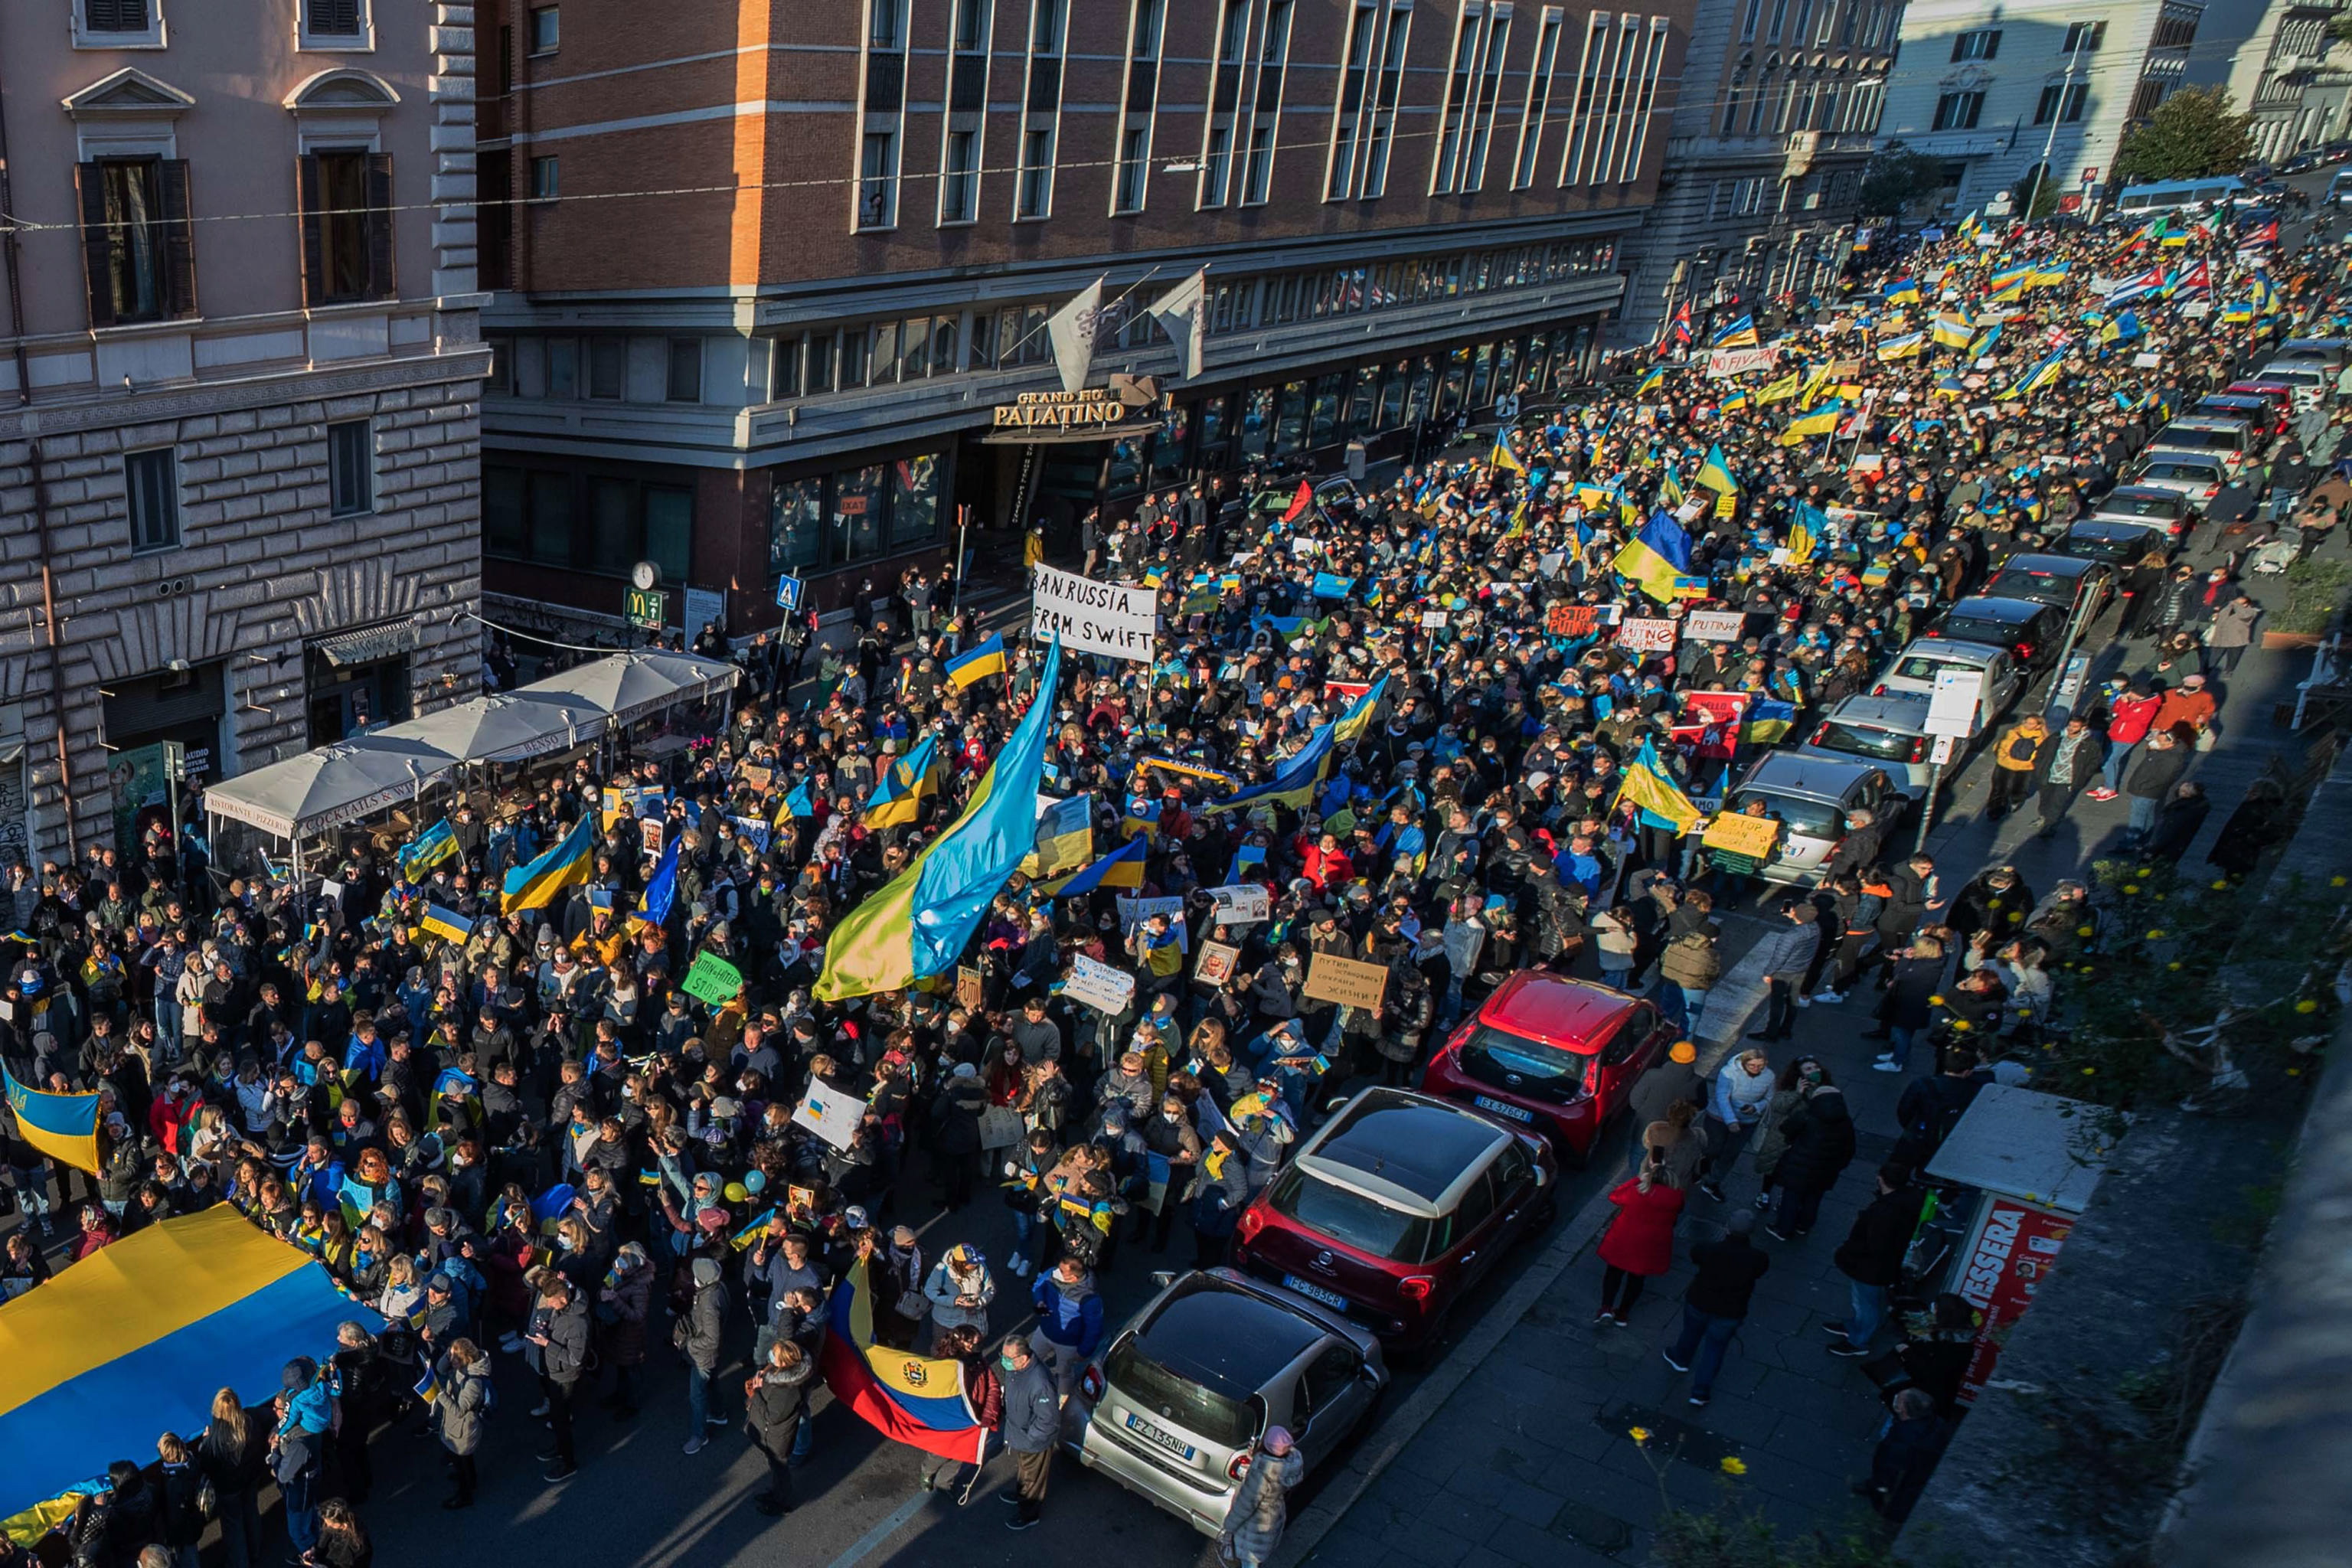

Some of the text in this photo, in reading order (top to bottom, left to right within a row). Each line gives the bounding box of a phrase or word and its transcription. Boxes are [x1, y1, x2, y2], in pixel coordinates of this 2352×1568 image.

[1018, 391, 1074, 404] GRAND
[994, 402, 1125, 426] PALATINO
[1033, 569, 1063, 597] BAN
[1034, 606, 1073, 635] FROM
[1560, 606, 1599, 621] STOP
[1548, 619, 1584, 635] PUTIN
[1622, 627, 1656, 640] PUTIN
[524, 735, 559, 753] BENSO
[210, 798, 288, 833] RISTORANTE PIZZERIA
[306, 795, 378, 832] COCKTAILS
[382, 791, 392, 802] &
[1318, 957, 1349, 969] ПУТИН
[692, 977, 719, 998] STOP
[1317, 973, 1355, 987] СОХРАНИ
[1960, 1210, 2026, 1310] TESSERA
[1135, 1419, 1187, 1454] FZ 135NH
